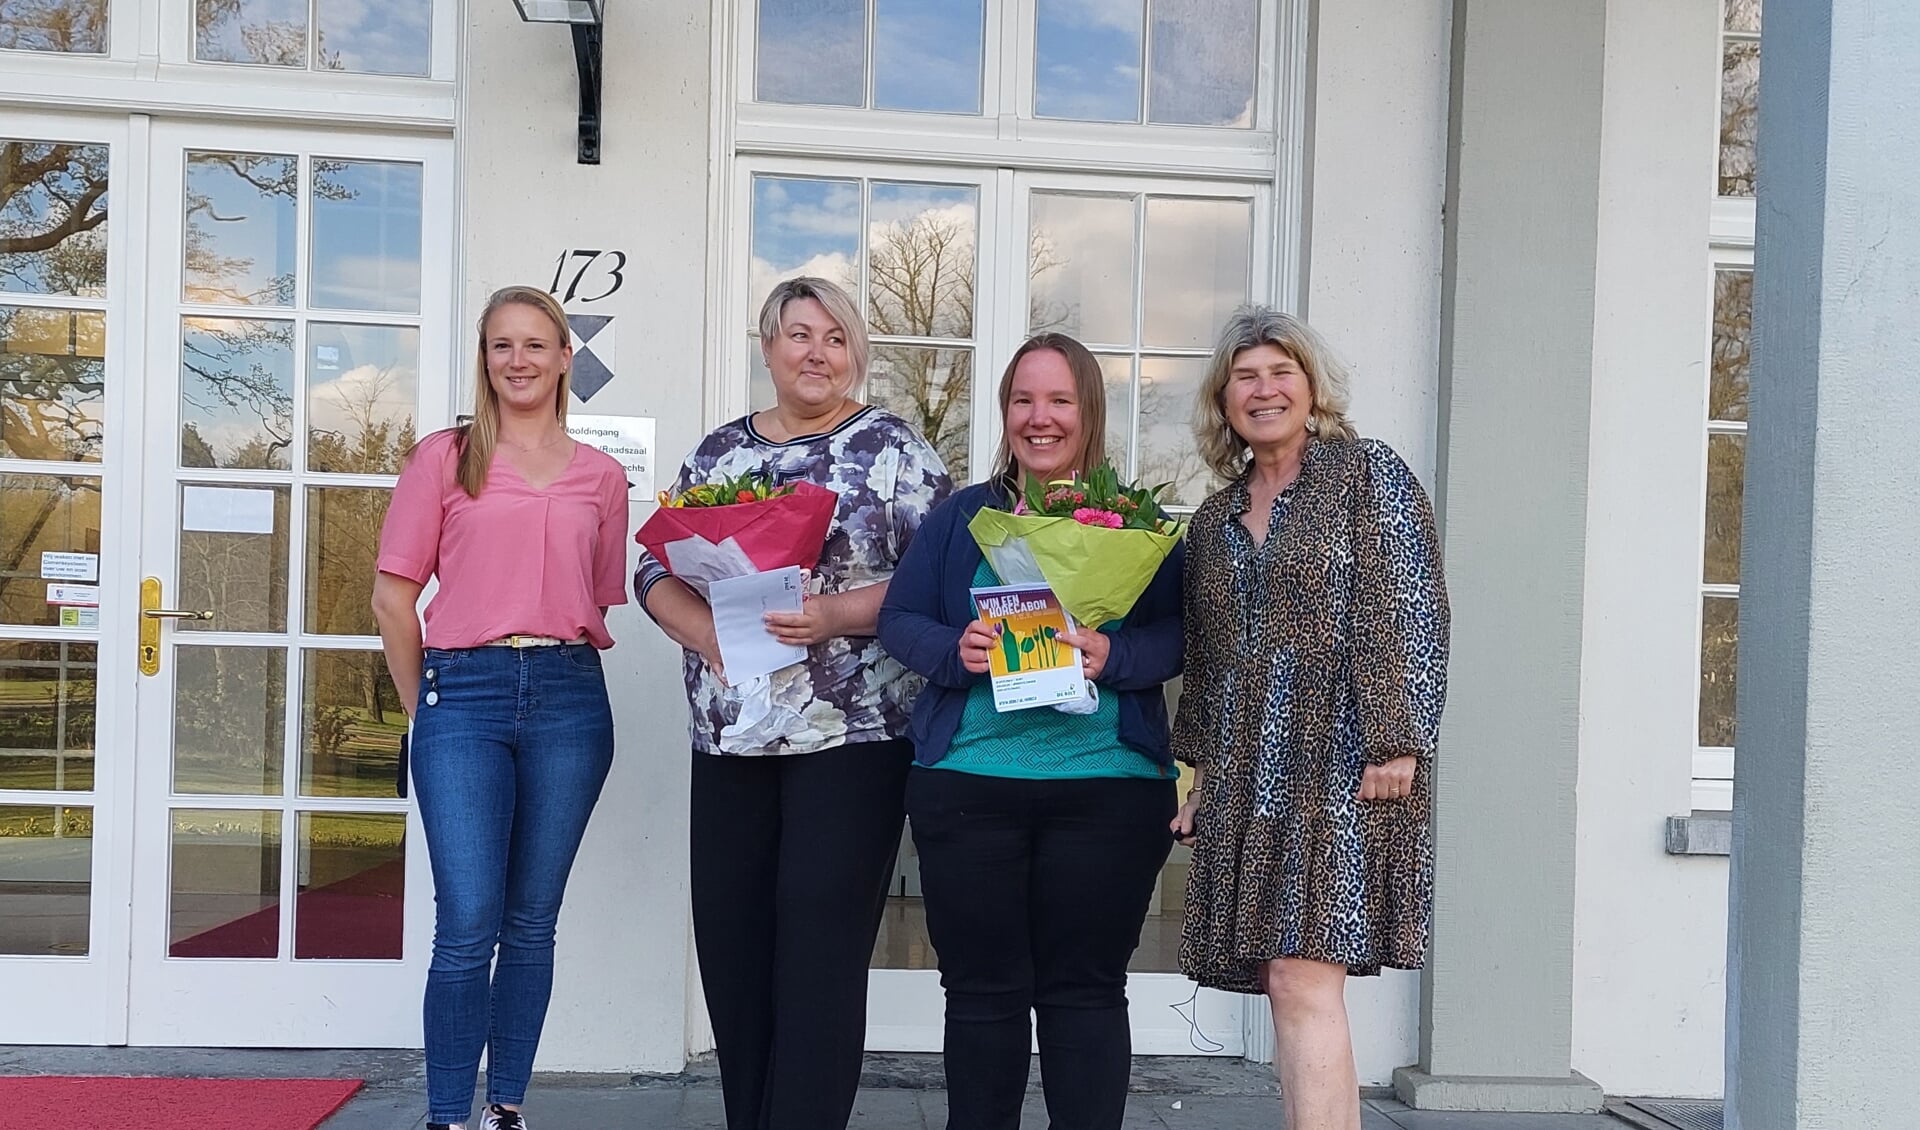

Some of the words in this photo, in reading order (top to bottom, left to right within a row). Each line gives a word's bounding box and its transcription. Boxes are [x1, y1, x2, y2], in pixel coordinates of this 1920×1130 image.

[549, 248, 627, 304] 173
[623, 464, 646, 473] echts
[979, 597, 1000, 610] WIN
[1001, 595, 1020, 607] EEN
[989, 600, 1046, 618] HORECABON
